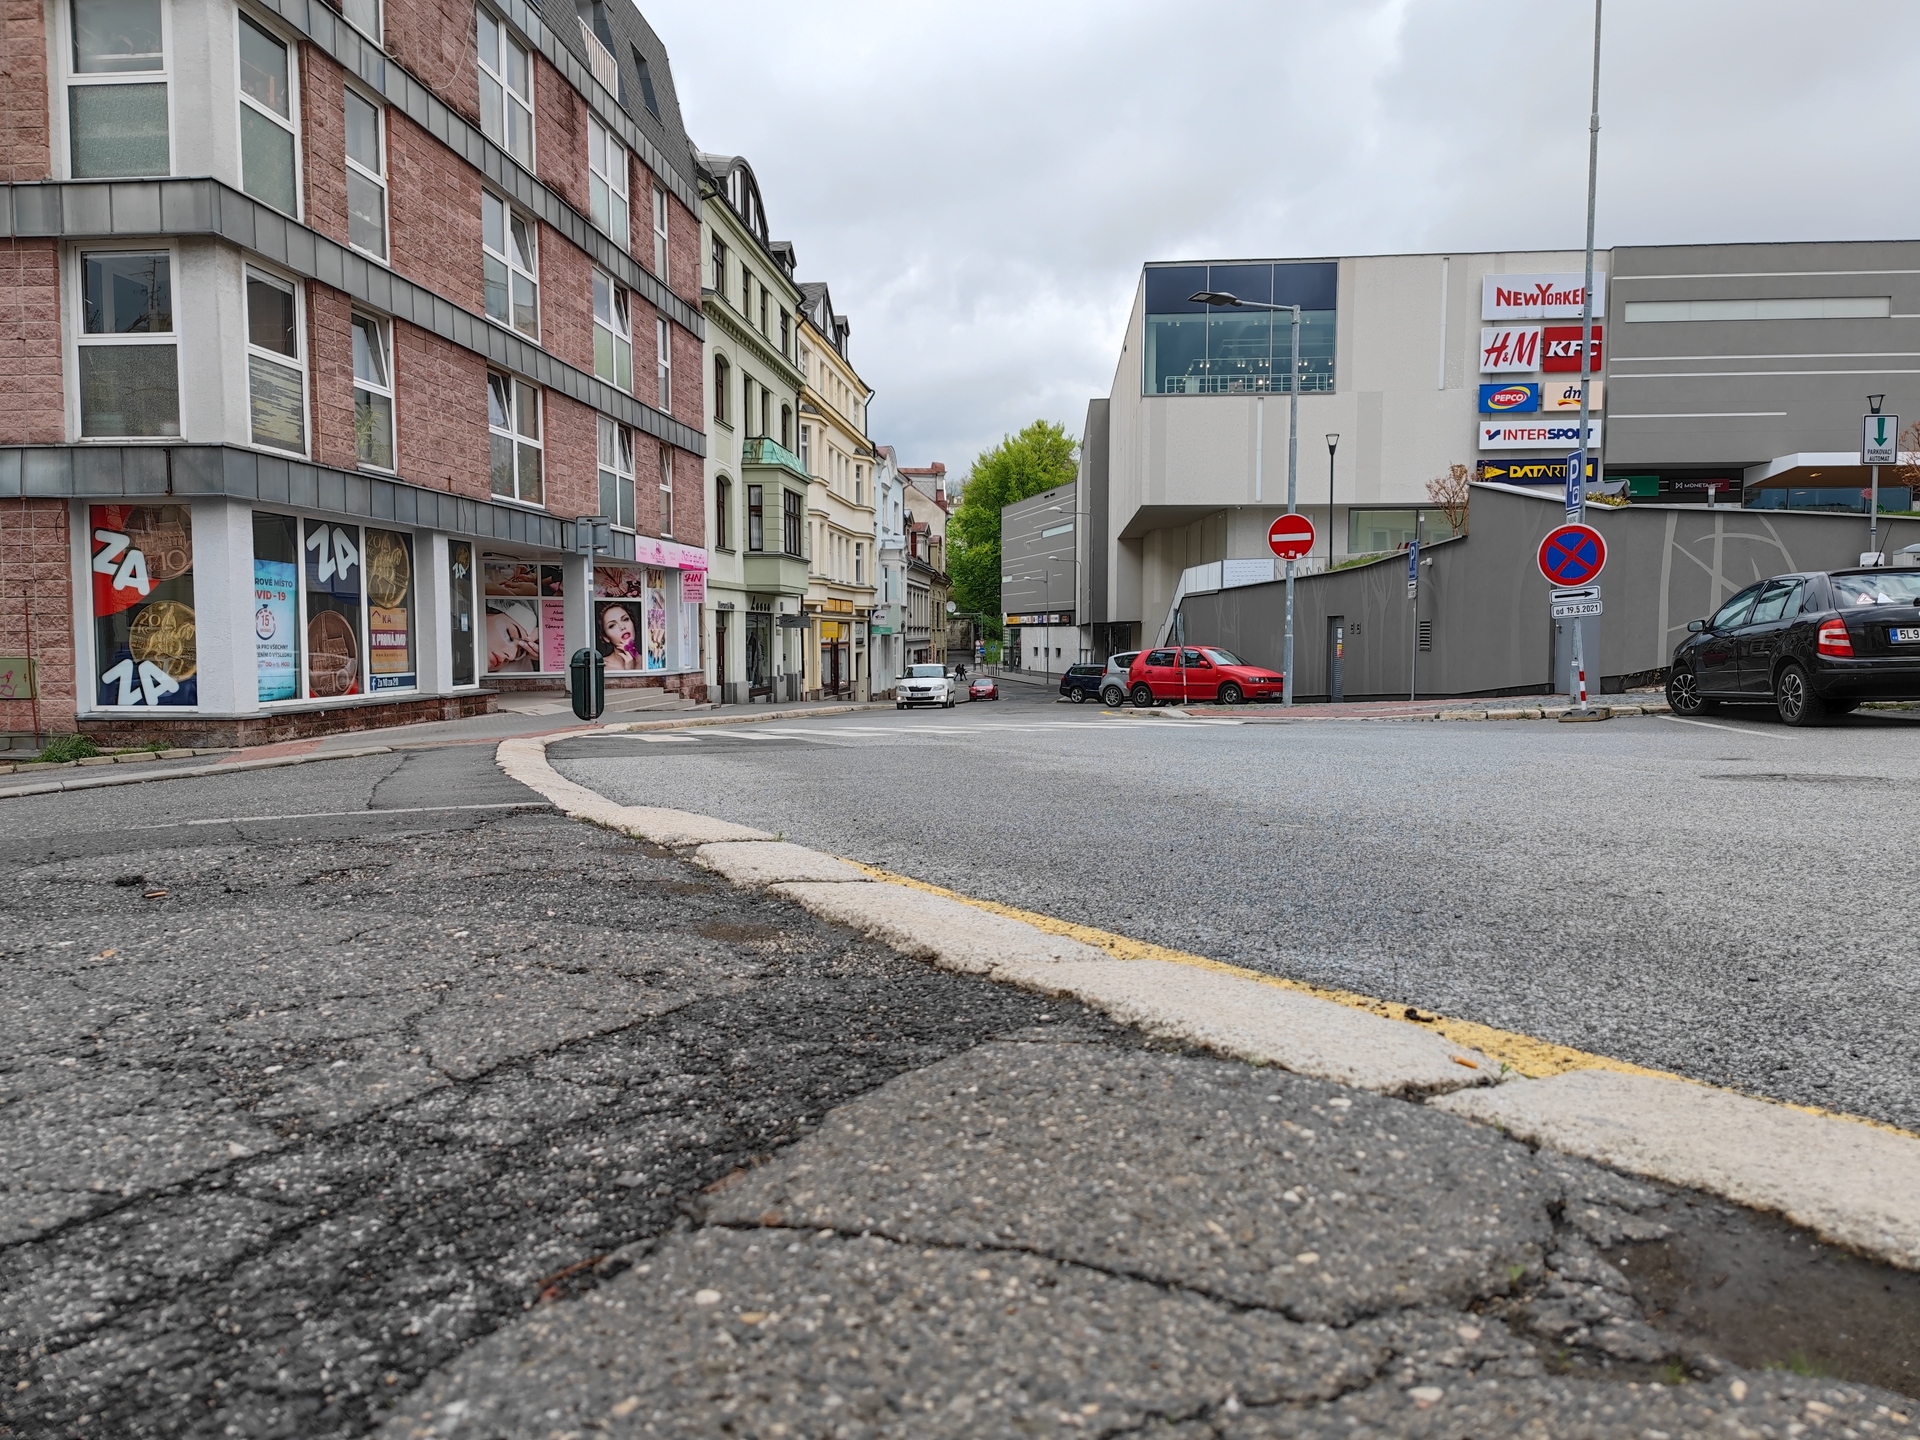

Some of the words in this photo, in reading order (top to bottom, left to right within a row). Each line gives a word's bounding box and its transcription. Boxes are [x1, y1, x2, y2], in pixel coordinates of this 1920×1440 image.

[1484, 331, 1539, 367] H&M
[1494, 393, 1525, 402] PEPCO
[1509, 465, 1567, 478] DATART
[1569, 459, 1579, 492] P
[161, 550, 187, 571] 10
[306, 523, 358, 583] ZA
[93, 529, 150, 596] ZA
[453, 562, 466, 579] ZA
[274, 578, 293, 588] MÍSTO
[255, 590, 272, 600] VID
[1567, 604, 1598, 613] 19.5.2021
[140, 612, 161, 627] 20
[261, 615, 270, 626] 15
[1900, 630, 1919, 639] 5L9
[102, 659, 179, 705] ZA
